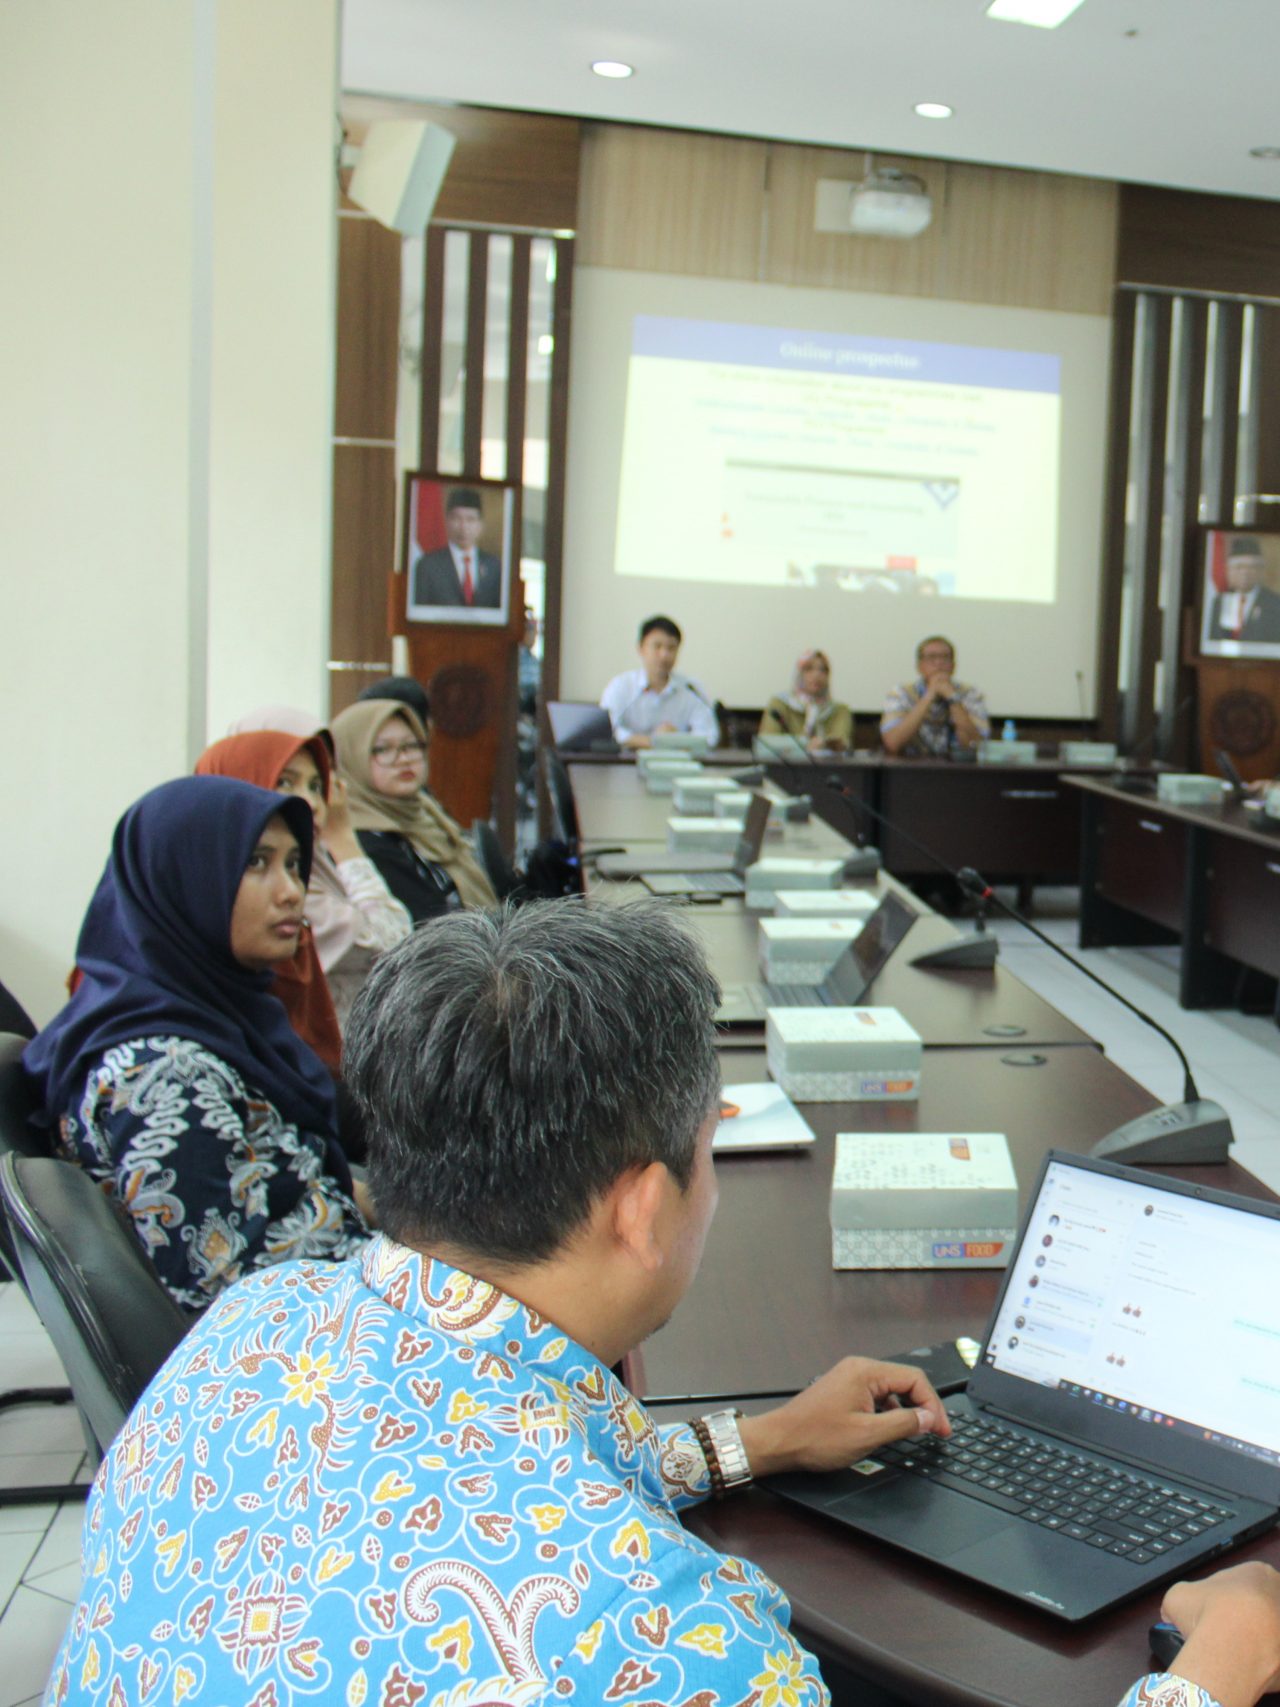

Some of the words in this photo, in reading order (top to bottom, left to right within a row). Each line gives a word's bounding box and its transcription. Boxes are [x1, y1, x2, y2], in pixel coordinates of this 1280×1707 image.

[779, 342, 832, 362] Online
[934, 1244, 961, 1258] UNS
[966, 1243, 994, 1257] FOOD
